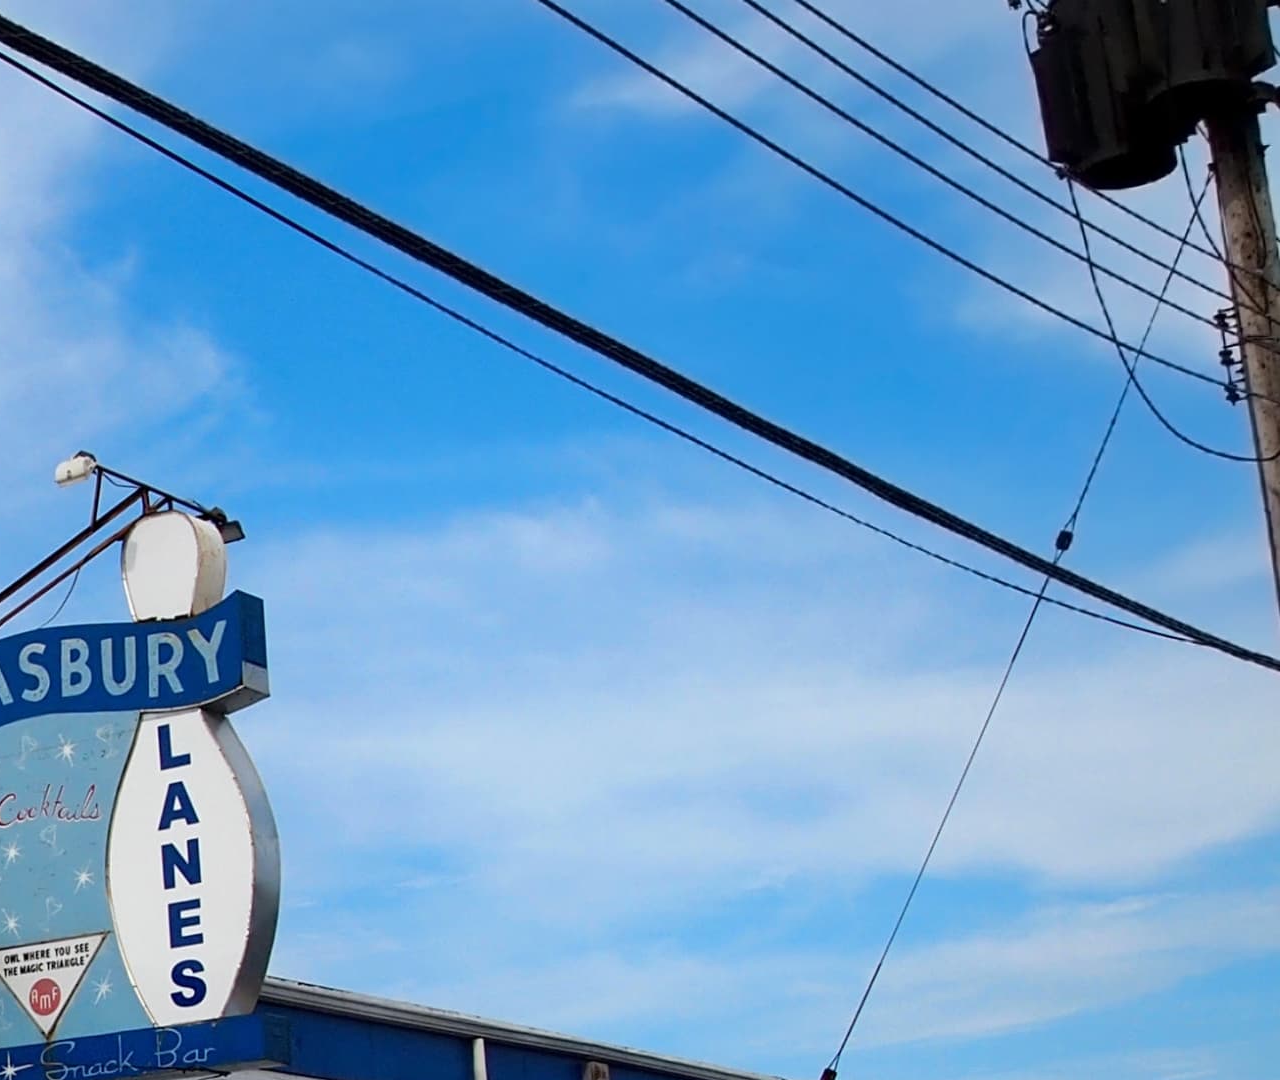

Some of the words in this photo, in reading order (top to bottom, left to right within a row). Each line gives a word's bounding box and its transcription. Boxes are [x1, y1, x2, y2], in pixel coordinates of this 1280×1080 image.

[156, 723, 208, 1008] LANES
[23, 949, 50, 961] WHERE
[55, 946, 70, 956] YOU
[75, 943, 90, 953] SEE
[3, 966, 18, 977] THE
[20, 962, 44, 974] MAGIC
[154, 1027, 217, 1069] Bar
